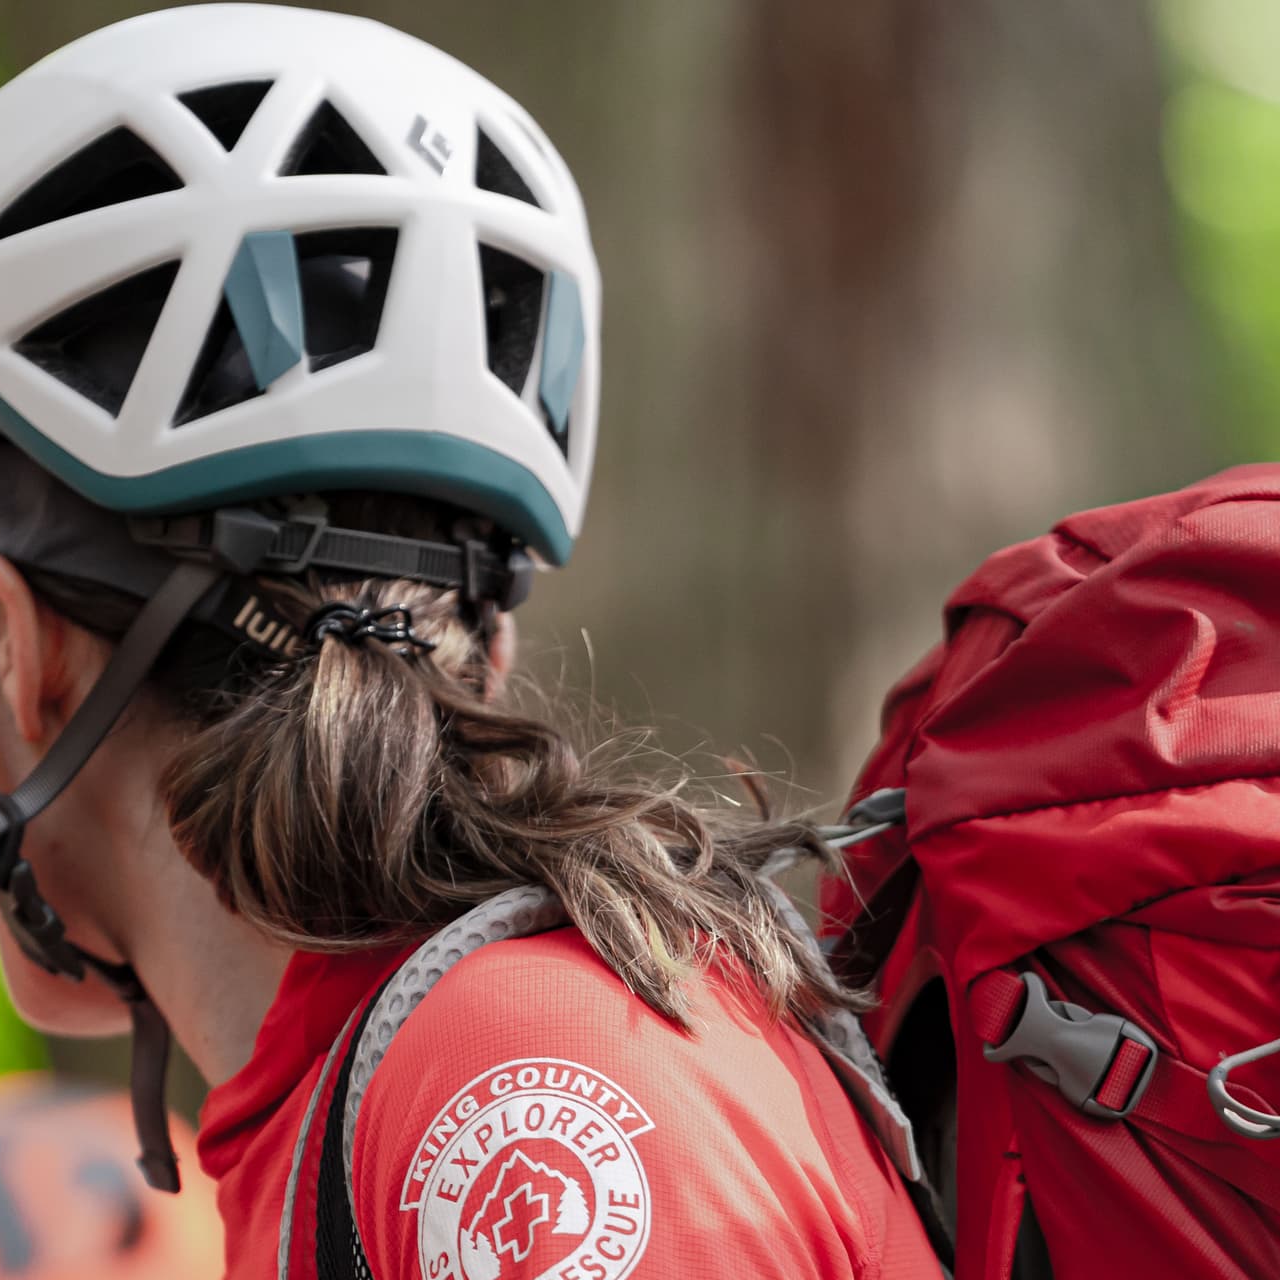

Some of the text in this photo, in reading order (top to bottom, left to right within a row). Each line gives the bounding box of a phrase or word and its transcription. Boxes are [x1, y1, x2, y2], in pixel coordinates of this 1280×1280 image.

[412, 1067, 638, 1183] KING COUNTY
[436, 1103, 621, 1204] EXPLORER
